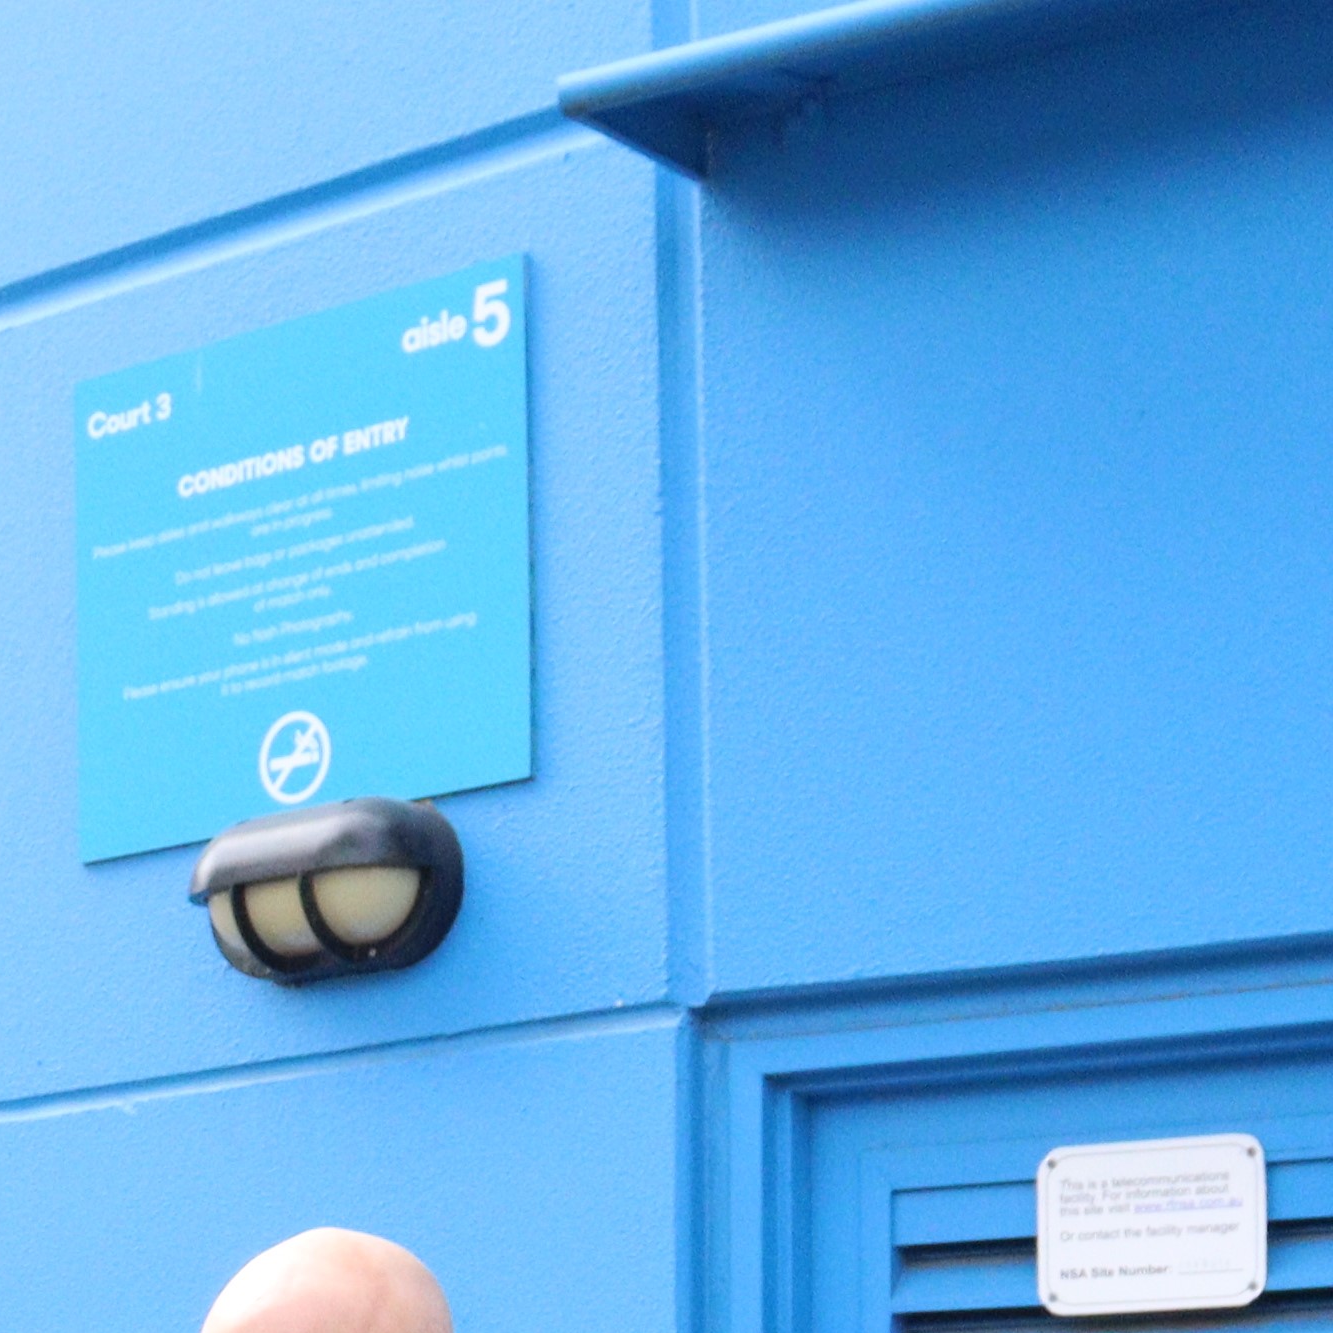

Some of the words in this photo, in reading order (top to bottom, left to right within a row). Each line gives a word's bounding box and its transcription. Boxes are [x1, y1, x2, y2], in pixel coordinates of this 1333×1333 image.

[401, 309, 467, 353] aisle
[472, 279, 511, 347] 5
[87, 401, 151, 439] Court
[155, 392, 172, 421] 3
[176, 446, 304, 498] CONDITIONS
[310, 435, 339, 463] OF
[342, 417, 409, 456] ENTRY
[1111, 1170, 1229, 1188] telecommunications
[1125, 1185, 1191, 1199] information
[1194, 1183, 1228, 1195] about
[1078, 1227, 1120, 1241] contact
[1123, 1226, 1141, 1238] the
[1145, 1224, 1182, 1238] facility
[1186, 1222, 1240, 1236] manager
[1090, 1266, 1113, 1278] Site
